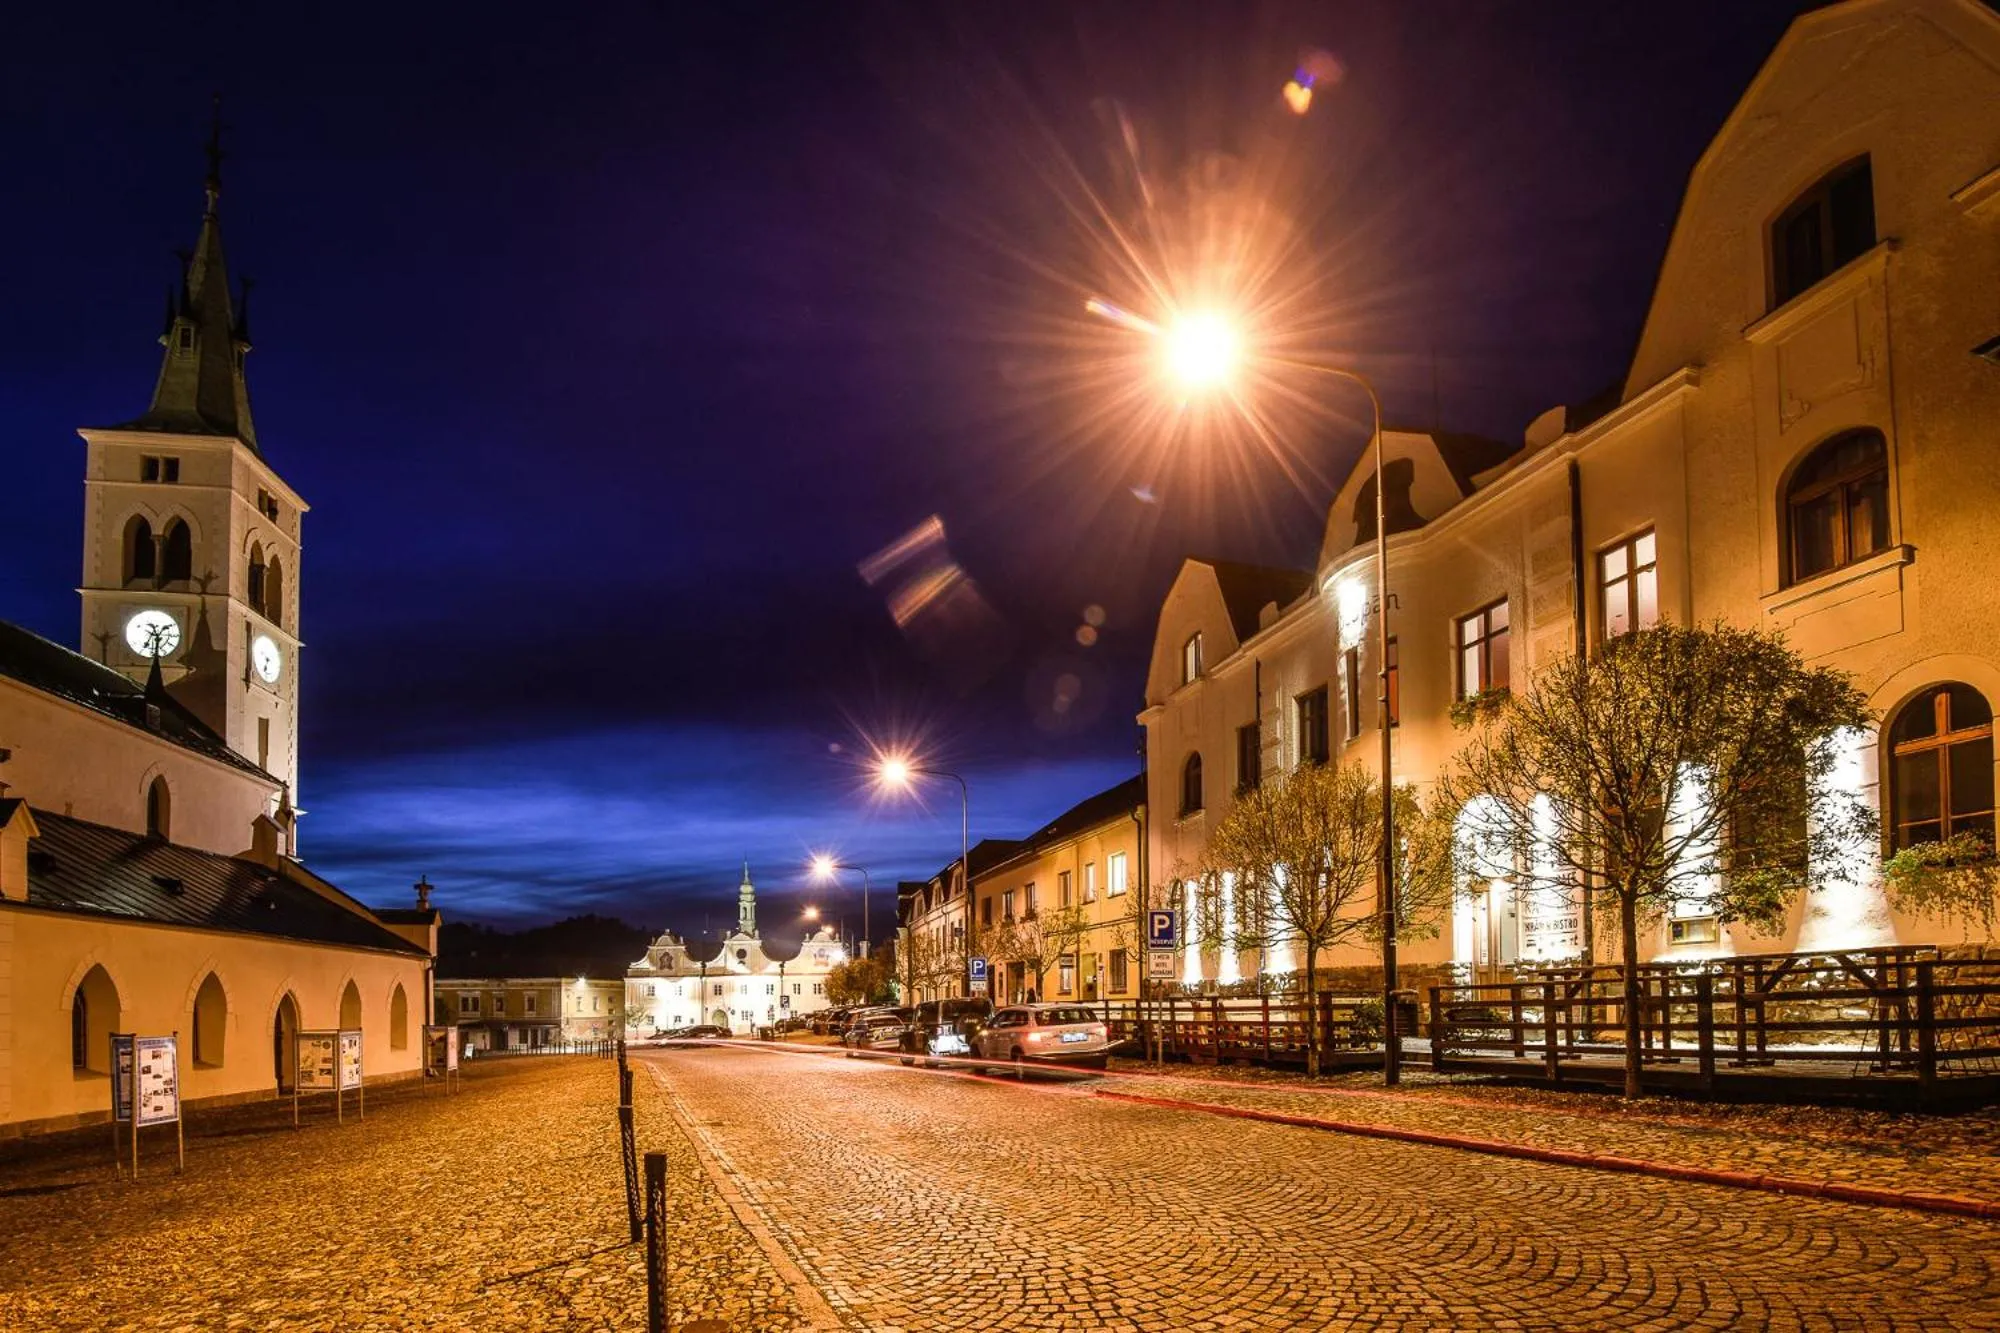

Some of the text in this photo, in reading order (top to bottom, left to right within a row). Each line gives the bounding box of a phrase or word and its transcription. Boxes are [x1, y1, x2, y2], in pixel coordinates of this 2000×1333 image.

[1153, 914, 1170, 937] P
[1553, 917, 1578, 930] BISTRO
[973, 960, 984, 974] P
